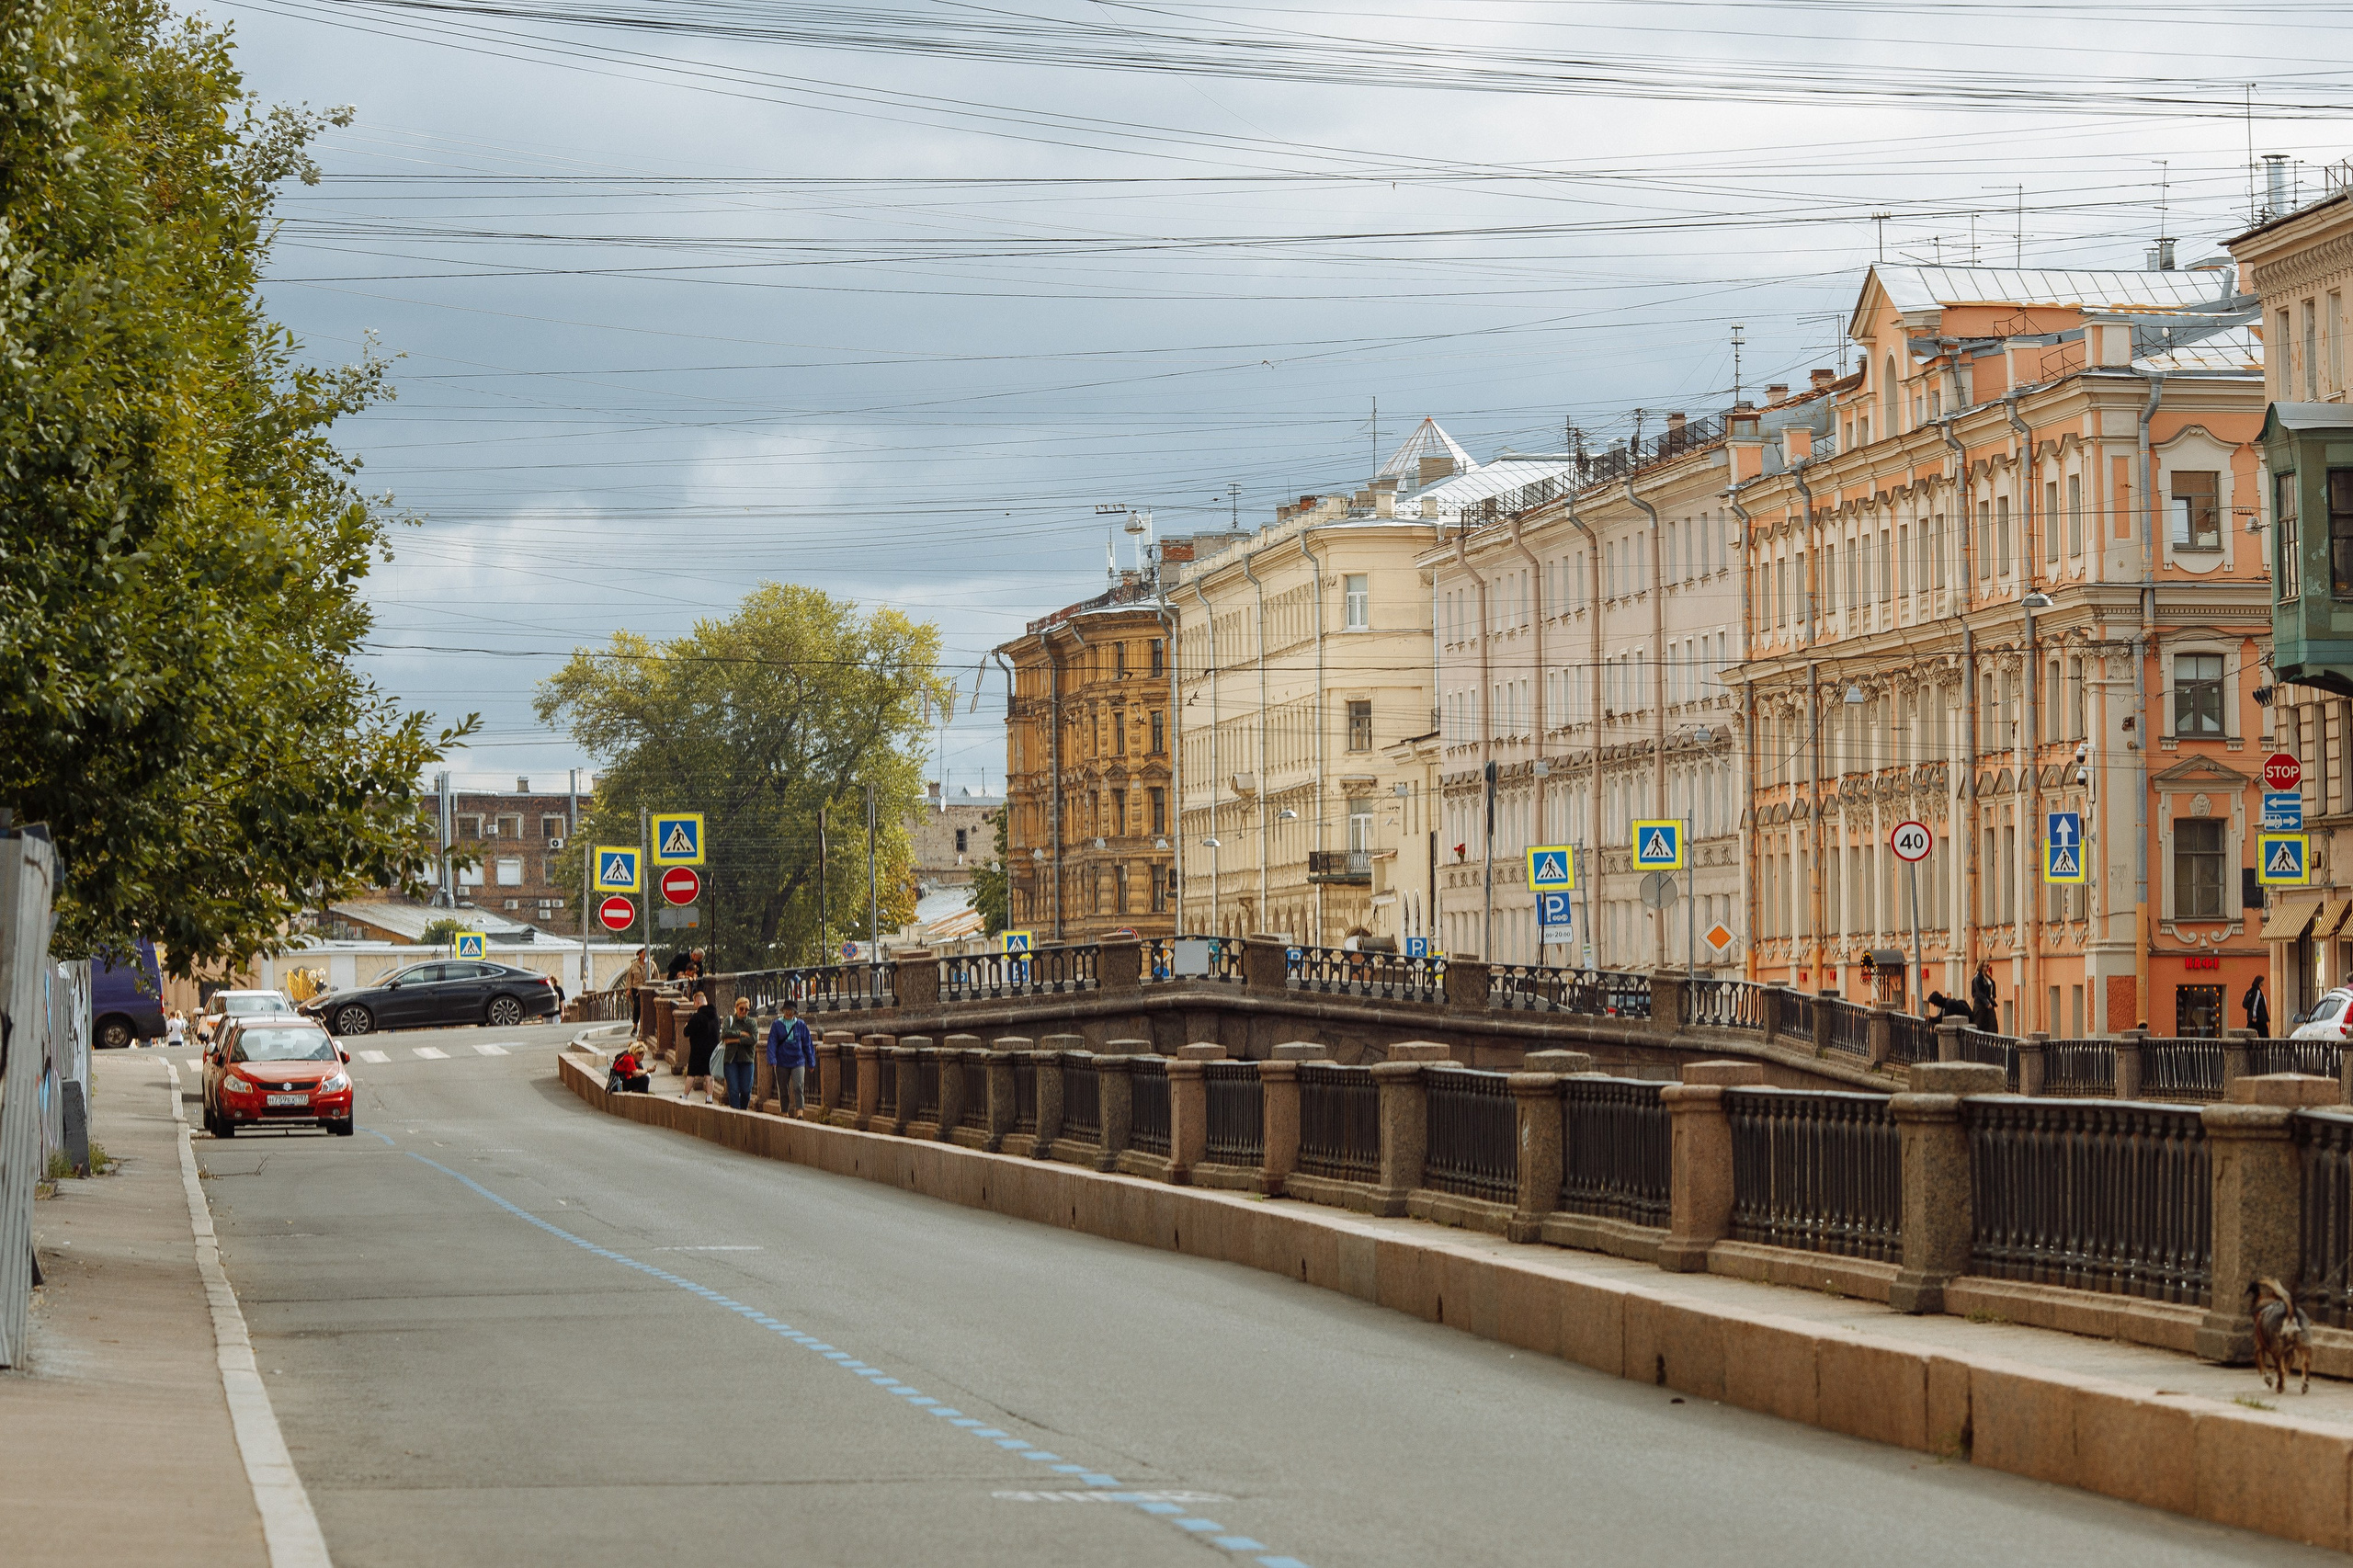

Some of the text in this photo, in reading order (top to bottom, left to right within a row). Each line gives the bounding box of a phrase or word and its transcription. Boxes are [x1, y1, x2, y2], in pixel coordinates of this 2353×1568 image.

[2266, 766, 2300, 778] STOP
[1899, 833, 1924, 849] 40
[1546, 895, 1564, 923] P
[1412, 938, 1424, 956] P
[2185, 957, 2220, 970] КАФЕ
